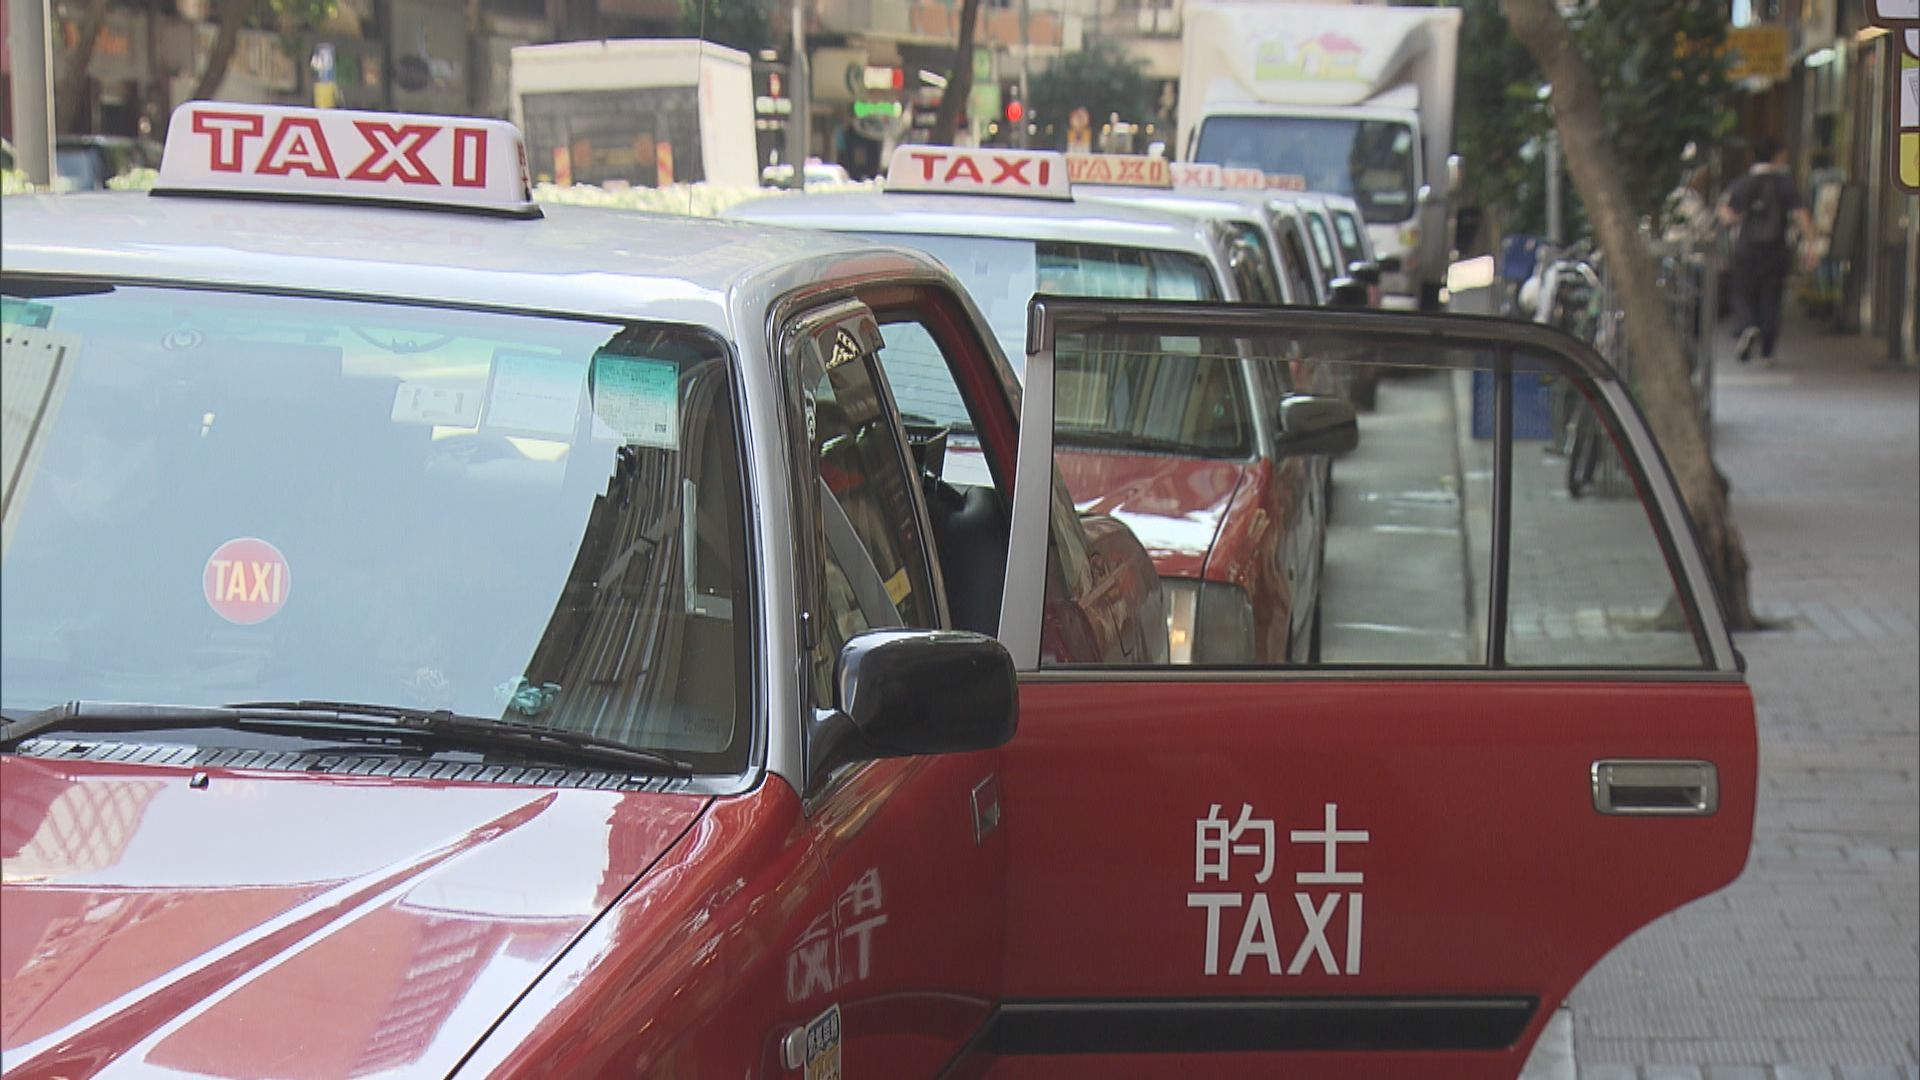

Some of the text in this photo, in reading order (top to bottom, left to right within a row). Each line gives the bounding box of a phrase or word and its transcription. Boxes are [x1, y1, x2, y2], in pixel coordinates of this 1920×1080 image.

[192, 110, 488, 188] TAXI
[910, 151, 1050, 186] TAXI
[1067, 157, 1163, 182] TAXI
[211, 559, 283, 605] TAXI
[1195, 802, 1369, 885] 的士
[1187, 892, 1363, 975] TAXI
